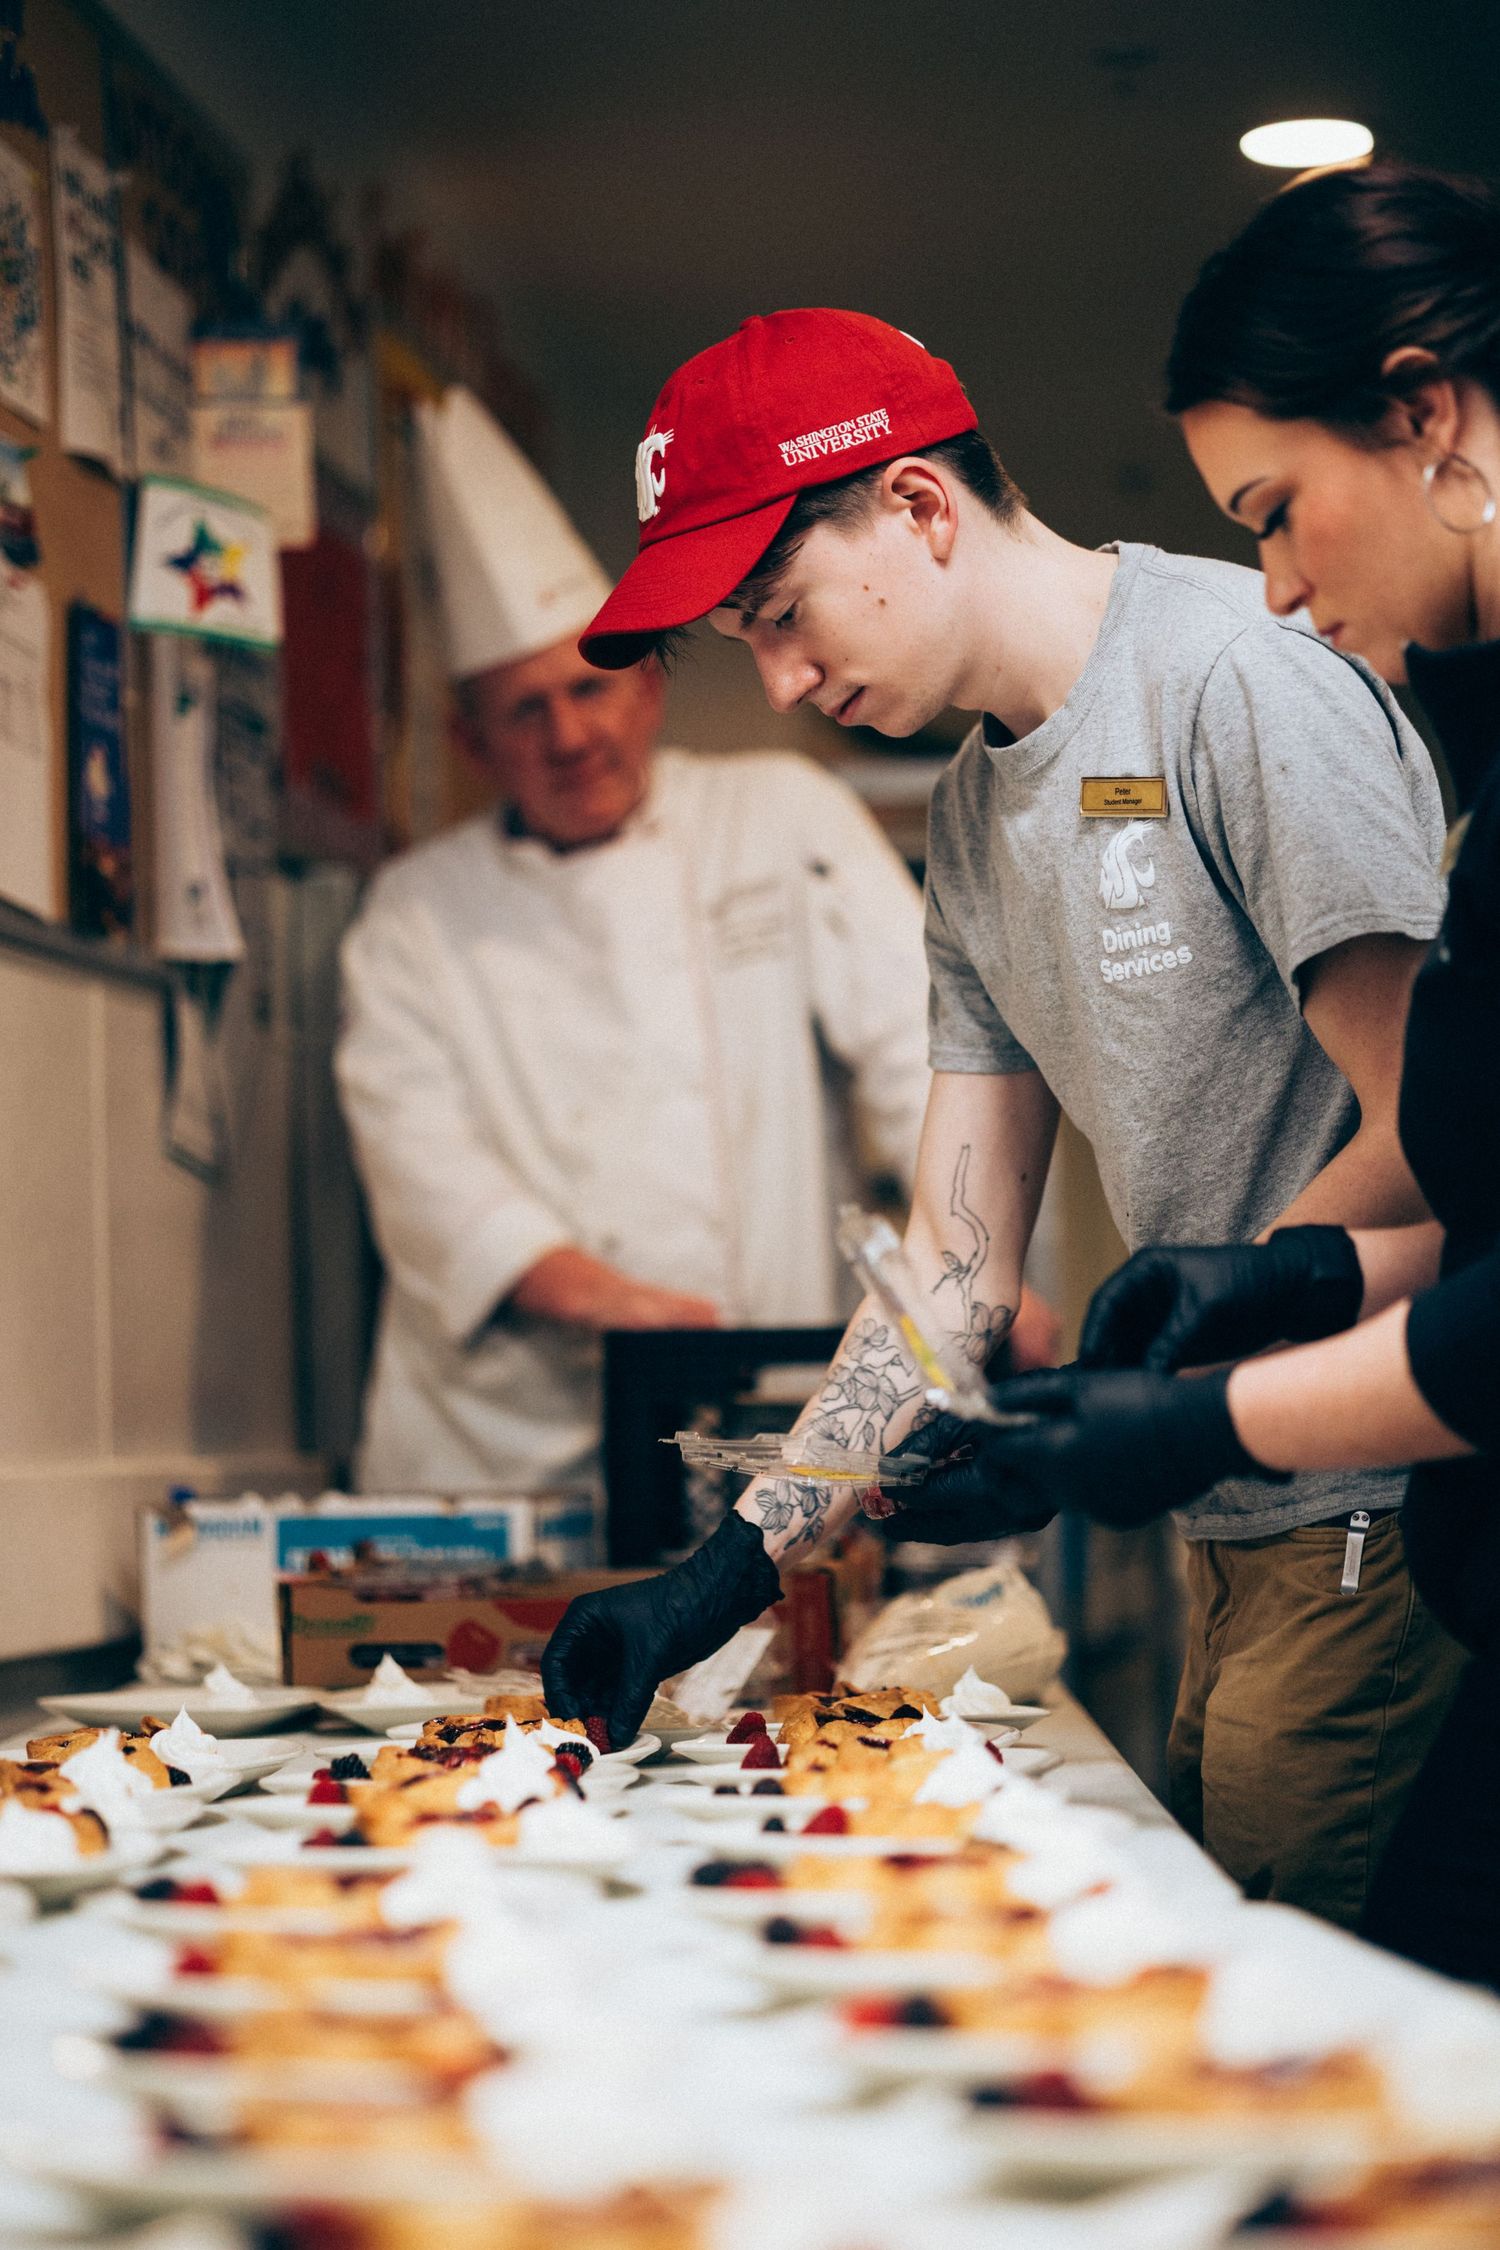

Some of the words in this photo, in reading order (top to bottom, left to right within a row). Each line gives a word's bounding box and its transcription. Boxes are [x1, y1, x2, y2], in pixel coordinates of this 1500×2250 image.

[778, 419, 856, 453] WASHINGTON
[856, 408, 889, 427] STATE
[781, 419, 892, 467] UNIVERSITY
[1114, 787, 1131, 796] Peter
[1122, 798, 1142, 806] Manager
[1102, 921, 1172, 954] Dining
[1100, 945, 1193, 984] Services
